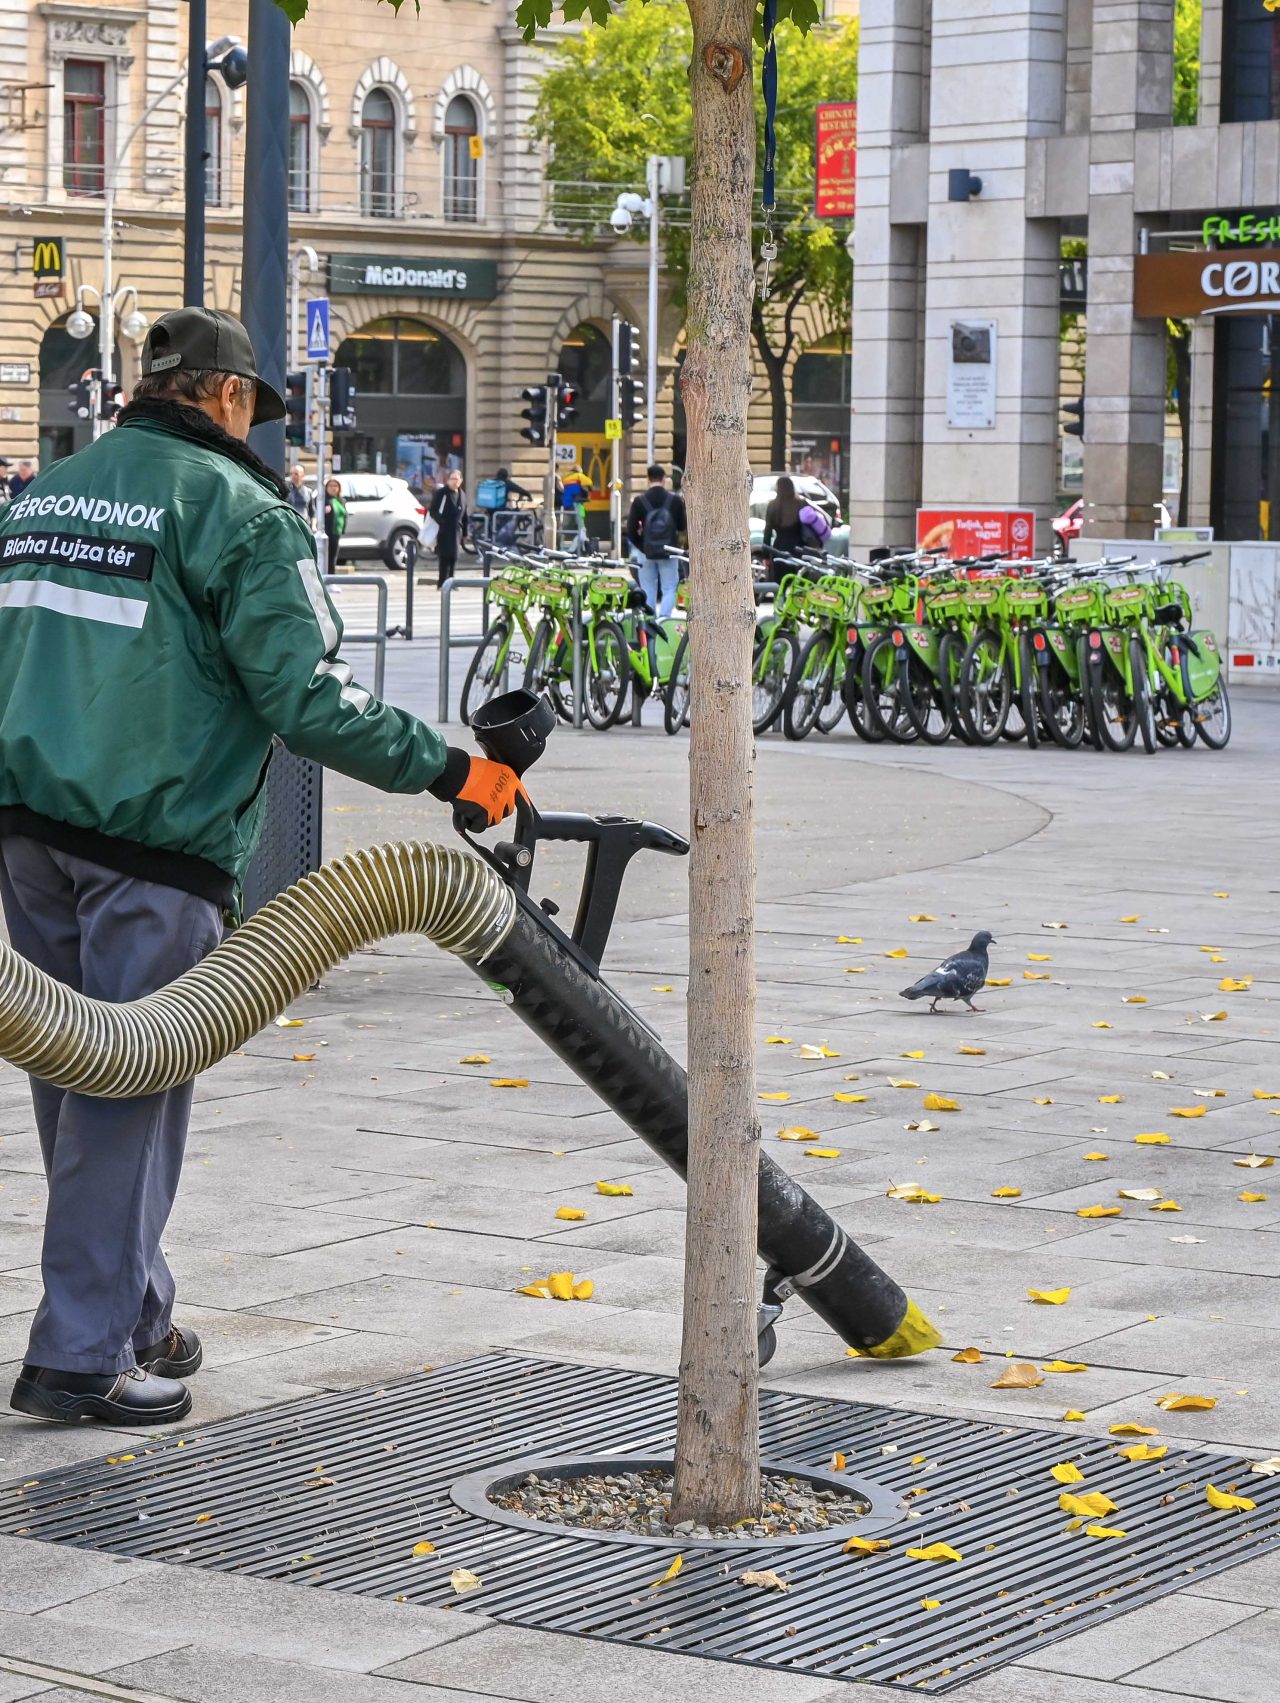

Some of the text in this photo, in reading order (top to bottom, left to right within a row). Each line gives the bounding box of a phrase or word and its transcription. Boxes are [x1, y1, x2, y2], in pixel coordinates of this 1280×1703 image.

[364, 265, 468, 290] McDonald's
[5, 494, 165, 532] TÉRGONDNOK
[3, 535, 135, 567] Blaha Lujza tér
